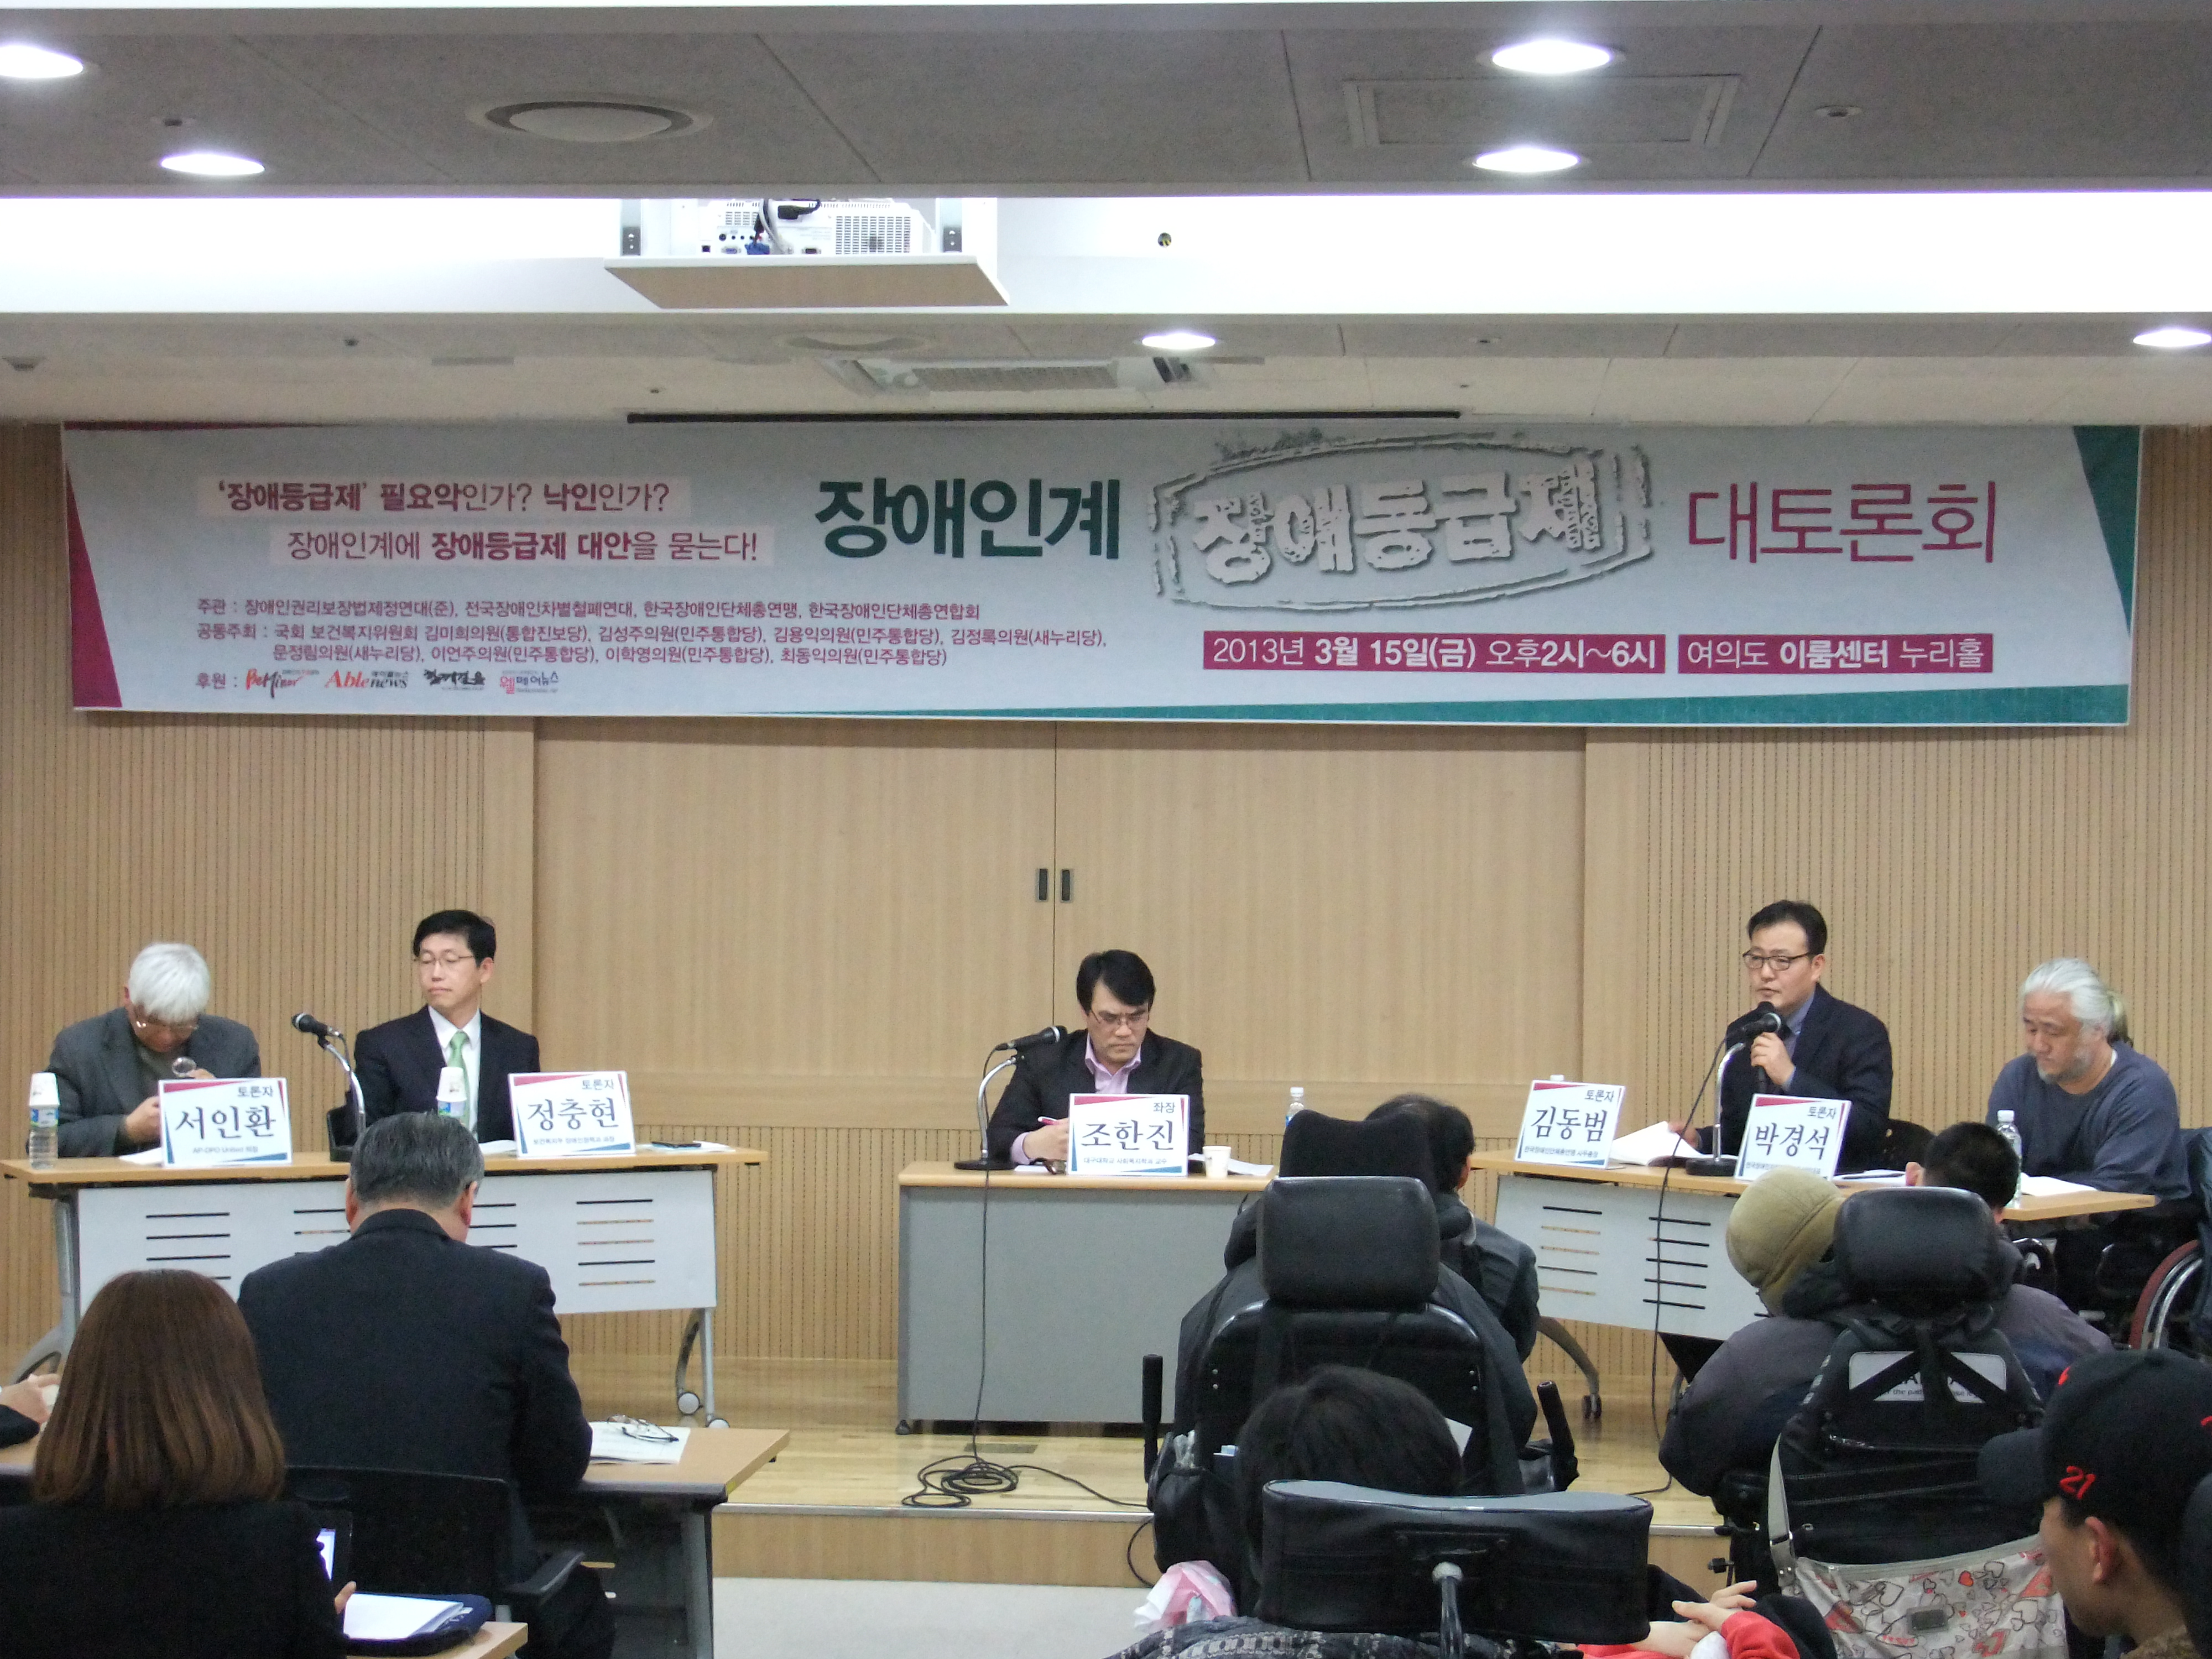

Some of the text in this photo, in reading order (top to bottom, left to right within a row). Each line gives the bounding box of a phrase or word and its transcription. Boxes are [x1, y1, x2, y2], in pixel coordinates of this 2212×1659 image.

[381, 483, 531, 511] 필요악인가?
[544, 483, 669, 510] 낙인인가?
[815, 459, 1997, 585] 장애인계 장애등급제 대토론회
[288, 531, 757, 560] 장애인계에 장애등급제 대안을 묻는다!
[197, 598, 226, 615] 주관
[465, 601, 637, 618] 전국장애인차별철폐연대,
[644, 601, 802, 620] 한국장애인단체총연맹,
[809, 602, 980, 620] 한국장애인단체총연합회
[275, 623, 305, 640] 국회
[311, 624, 418, 641] 보건복지위원회
[425, 625, 591, 643] 김미희의원(통합진보당),
[599, 625, 766, 643] 김성주의원(민주통합당),
[775, 627, 943, 645] 김용익의원(민주통합당),
[951, 628, 1107, 647] 김정록의원(새누리당),
[273, 644, 947, 666] 문정림의원(새누리당), 이언주의원(민주통합당), 이학영의원(민주통합당), 최동익의원(민주통합당)
[1213, 639, 1984, 669] 2013년 3월 15일(금) 오후2시~6시 여의도 이룸센터 누리홀
[196, 672, 226, 690] 후원
[237, 1085, 274, 1098] 토론자
[582, 1079, 614, 1091] 토론자
[1584, 1089, 1615, 1103] 토론자
[528, 1097, 619, 1131] 정충현
[1153, 1102, 1176, 1113] 좌장
[1807, 1106, 1837, 1120] 토론자
[175, 1105, 276, 1139] 서인환
[1081, 1119, 1174, 1151] 조한진
[1531, 1106, 1608, 1142] 김동범
[1755, 1123, 1830, 1161] 박경석
